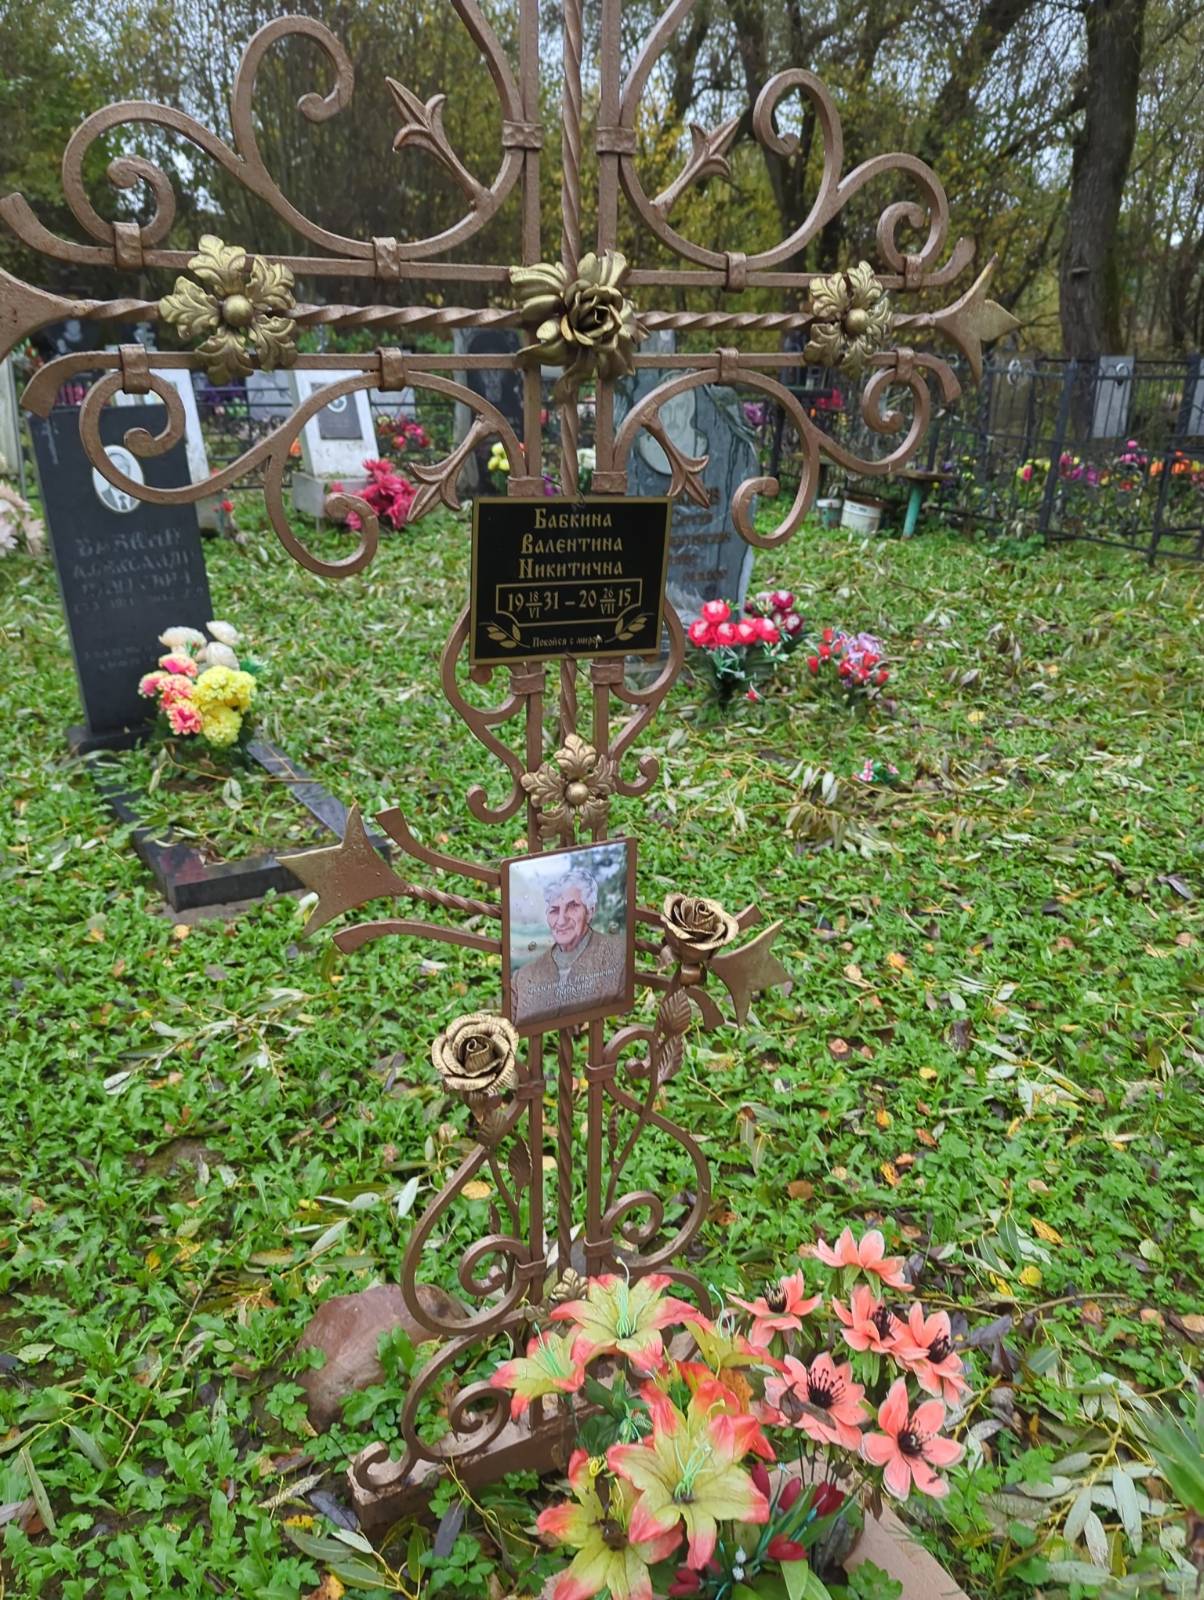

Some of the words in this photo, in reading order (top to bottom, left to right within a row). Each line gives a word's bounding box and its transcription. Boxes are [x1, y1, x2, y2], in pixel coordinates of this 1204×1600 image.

[534, 508, 613, 529] Бабкина
[521, 533, 623, 554] Валентина
[518, 558, 623, 579] Никитична
